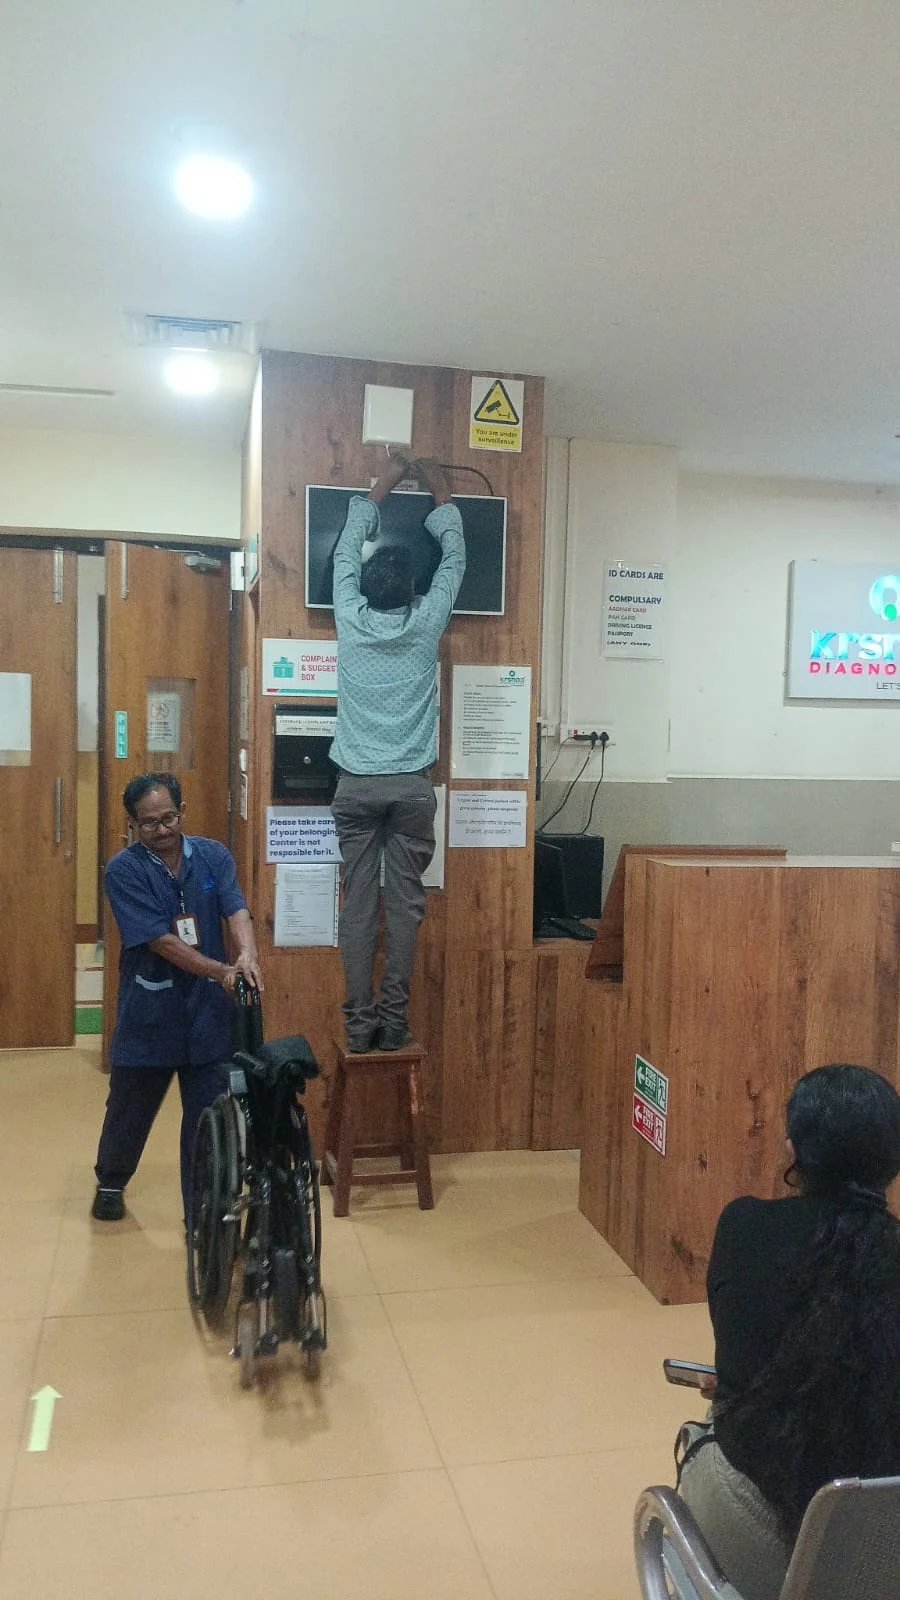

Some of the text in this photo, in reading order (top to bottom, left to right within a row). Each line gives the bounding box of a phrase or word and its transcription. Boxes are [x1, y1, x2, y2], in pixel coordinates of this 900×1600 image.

[619, 570, 646, 579] CARDS
[647, 572, 664, 580] ARE
[608, 594, 662, 604] COMPULSARY
[300, 828, 340, 836] belonging
[270, 848, 312, 858] resposible
[645, 1076, 656, 1092] EXIT
[643, 1105, 654, 1121] FIRE
[642, 1115, 653, 1131] EXIT
